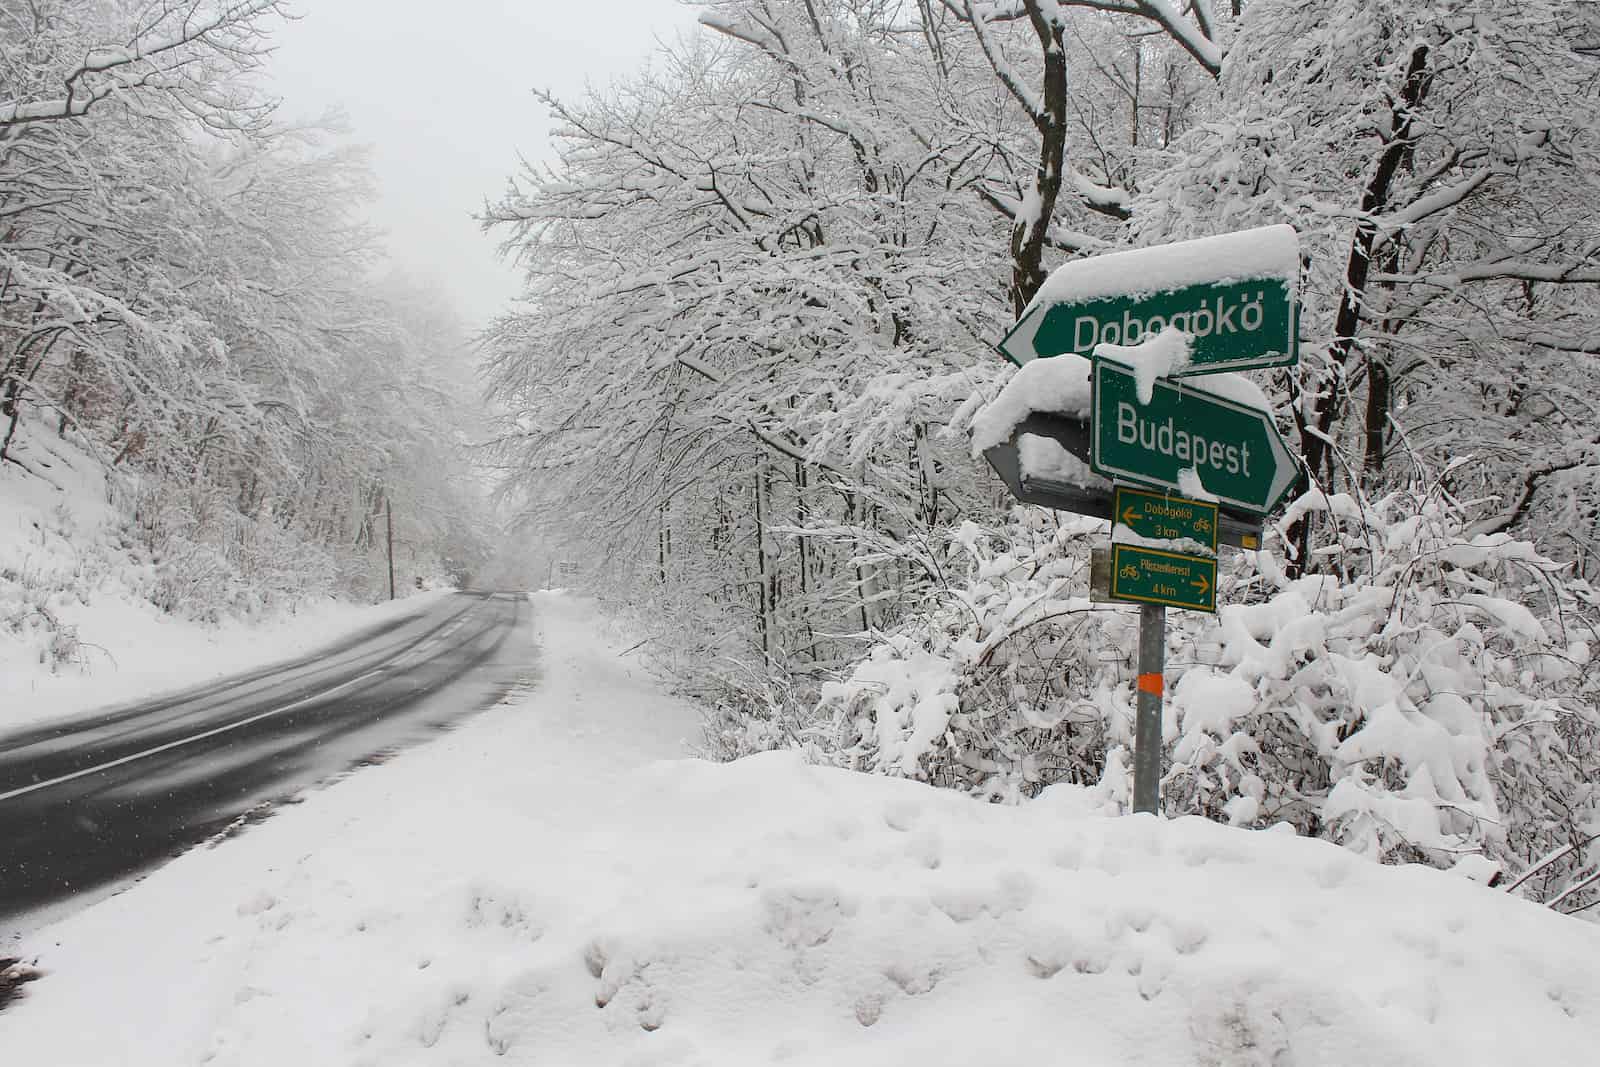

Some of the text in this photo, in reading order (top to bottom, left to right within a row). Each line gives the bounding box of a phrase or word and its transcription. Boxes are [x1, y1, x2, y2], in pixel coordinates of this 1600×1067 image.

[1118, 401, 1250, 478] Budapest
[1155, 525, 1178, 538] 3 km
[1152, 584, 1176, 597] 4 km
